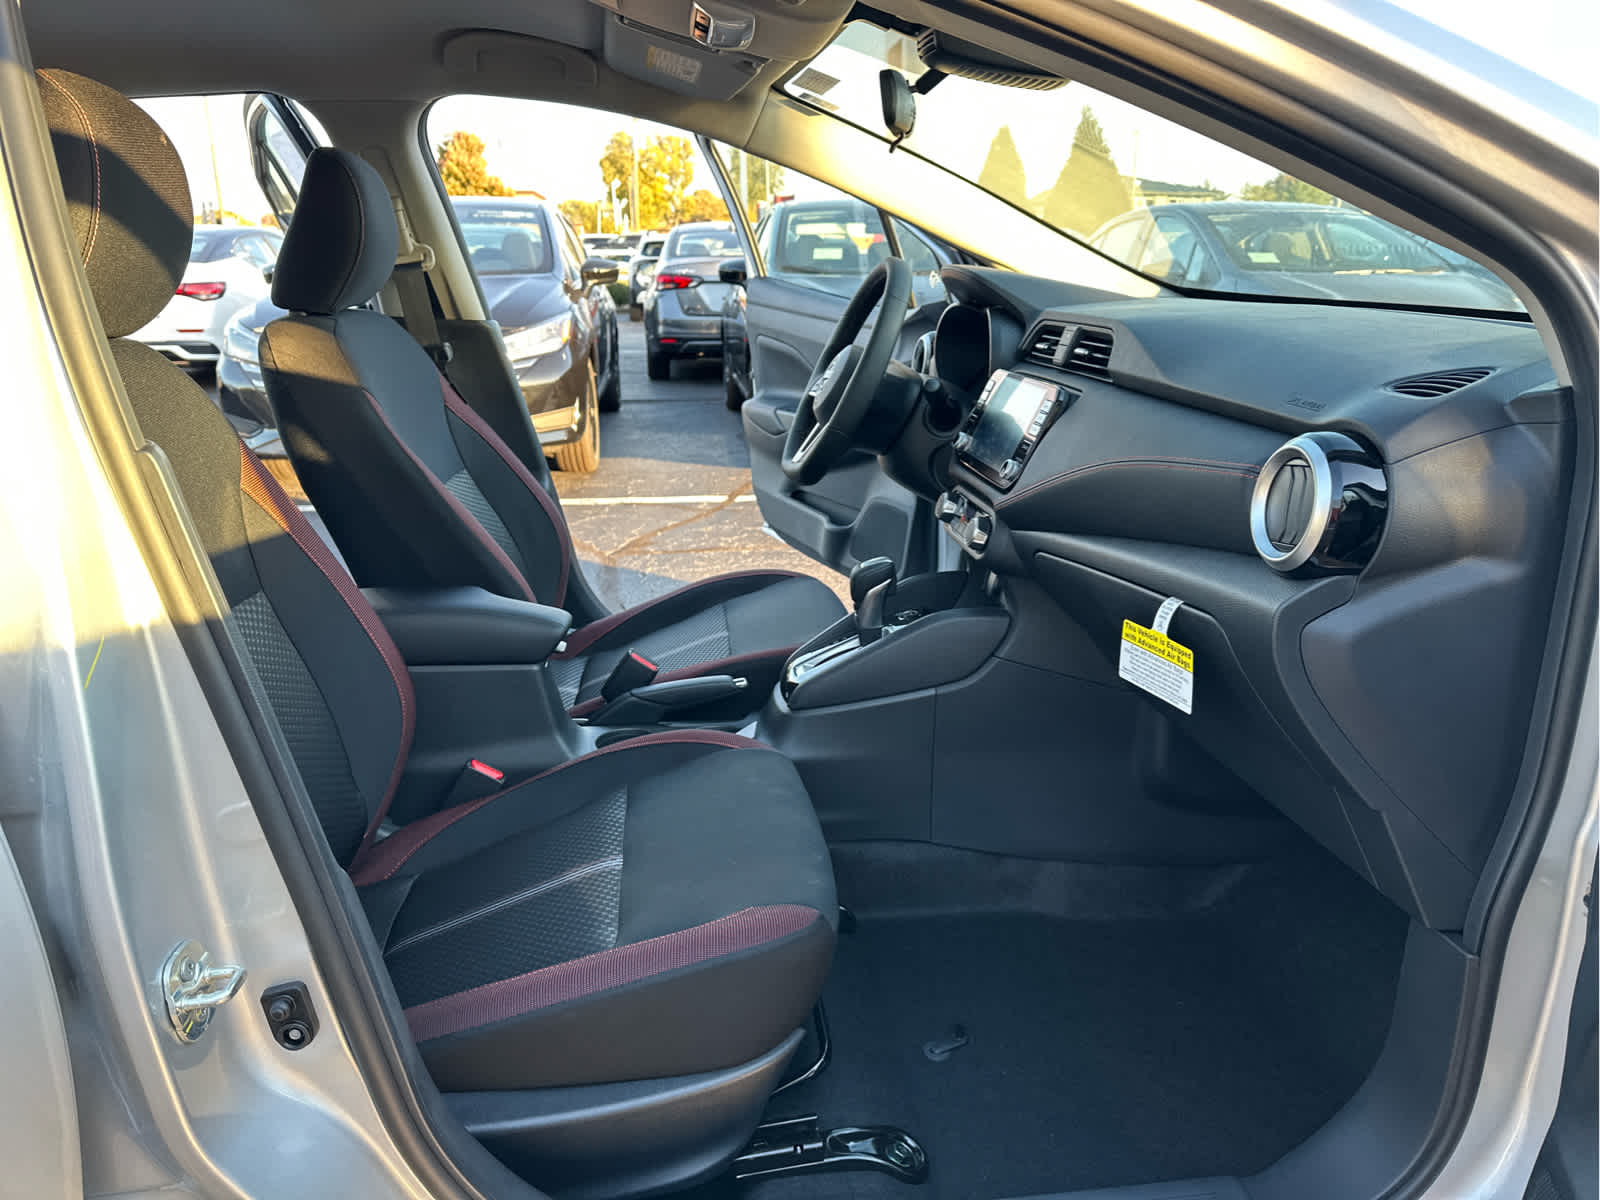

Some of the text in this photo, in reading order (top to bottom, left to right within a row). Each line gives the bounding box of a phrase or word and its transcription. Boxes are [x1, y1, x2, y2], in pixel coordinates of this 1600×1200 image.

[1124, 633, 1137, 642] with
[1138, 638, 1166, 655] Advanced
[1167, 651, 1176, 660] Air
[1125, 621, 1137, 632] This
[1138, 628, 1158, 642] Vehicle
[1166, 640, 1191, 659] Equipped
